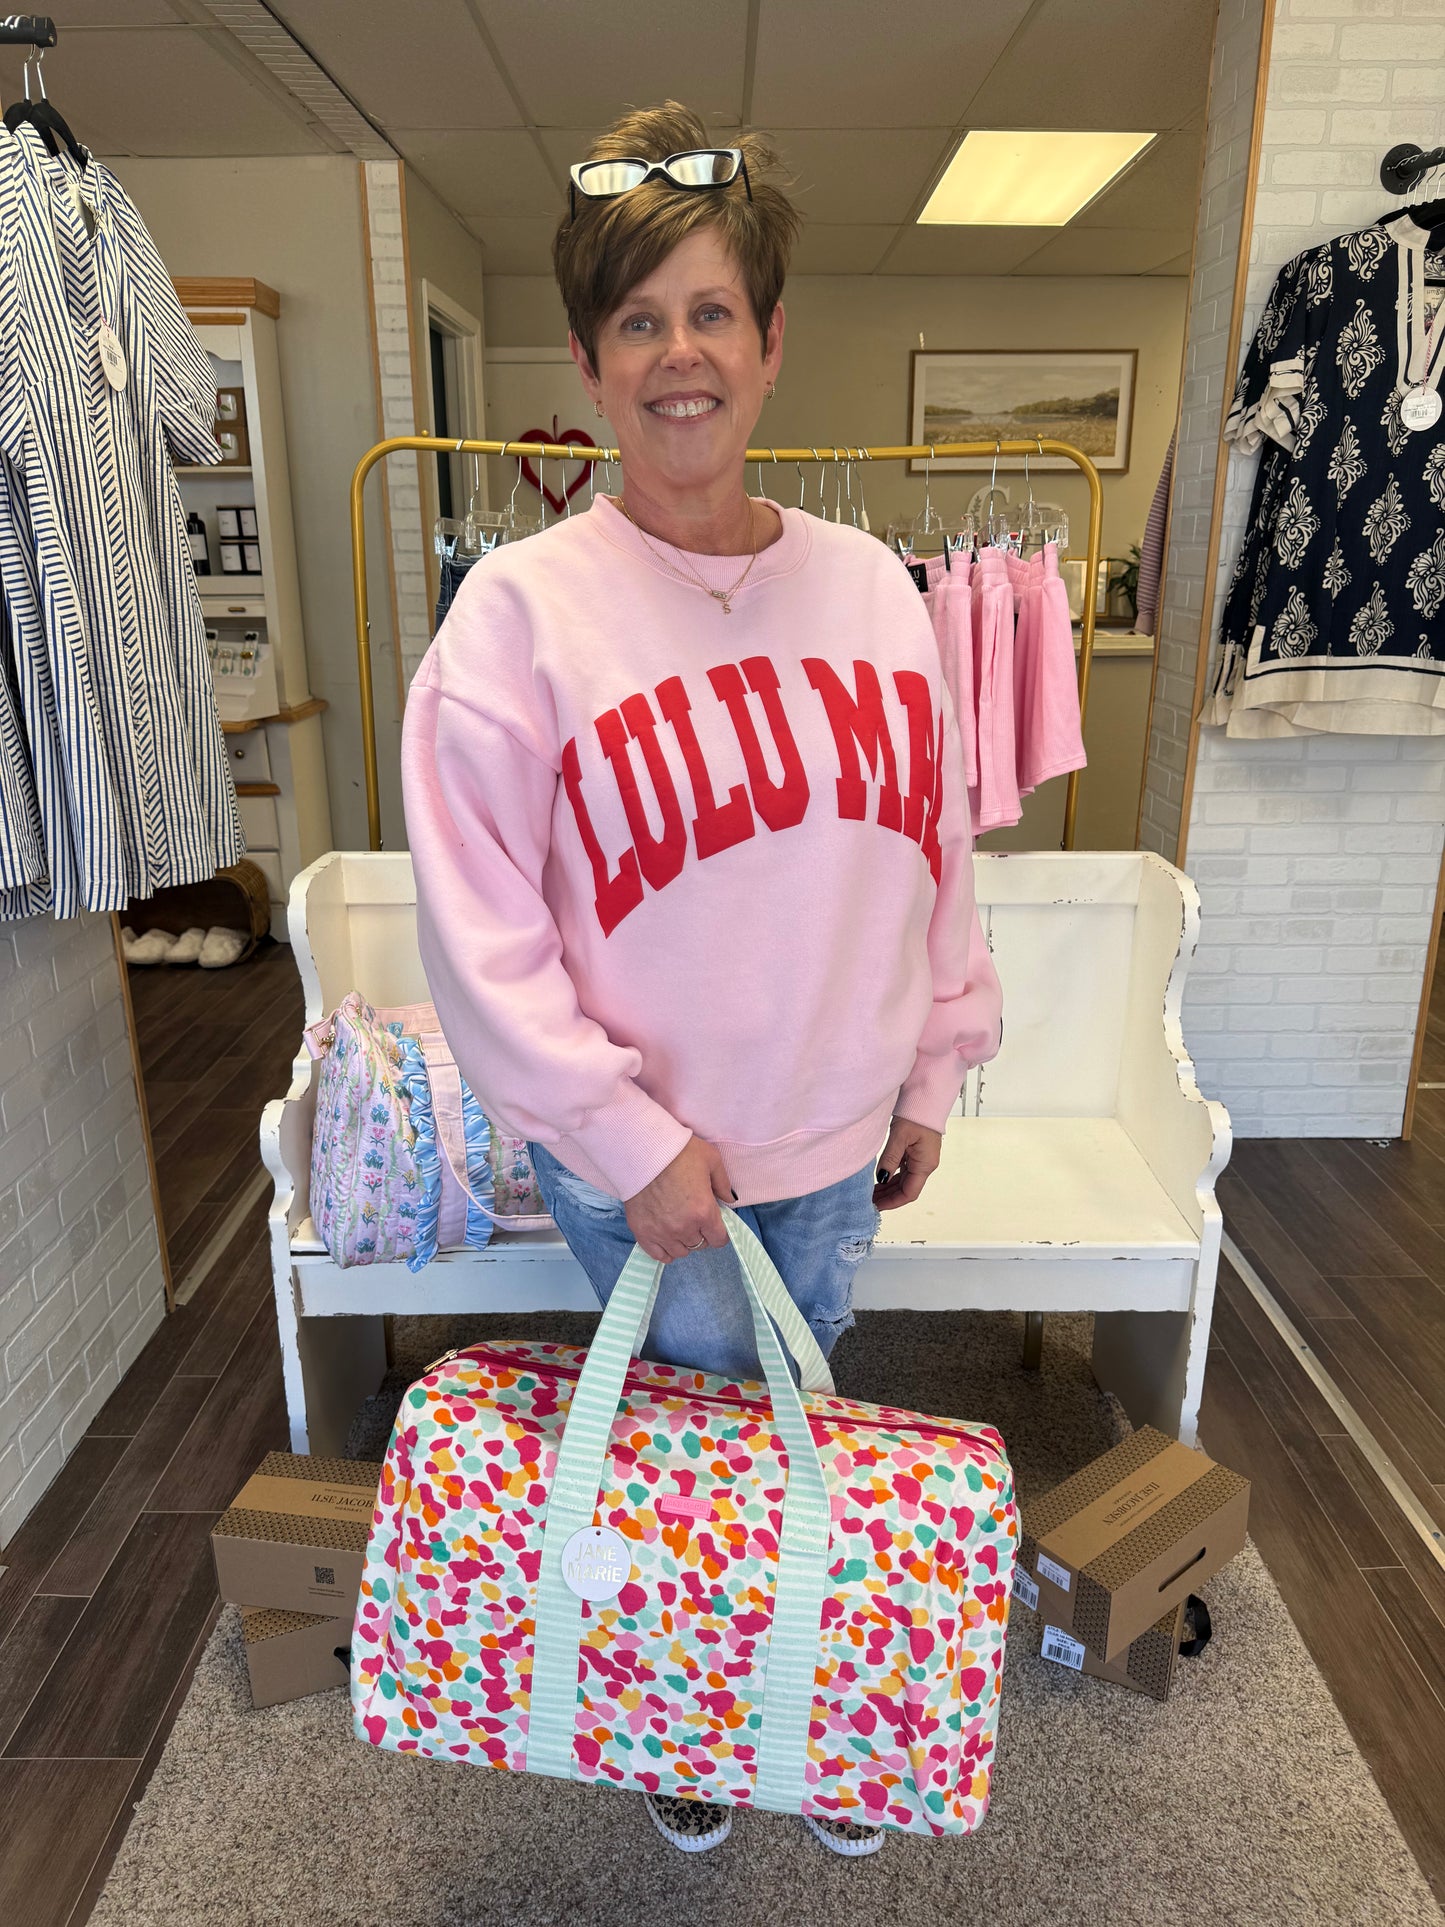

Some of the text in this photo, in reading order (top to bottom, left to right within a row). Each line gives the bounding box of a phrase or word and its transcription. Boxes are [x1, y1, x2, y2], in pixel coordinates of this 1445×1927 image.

[561, 656, 811, 940] LULU
[311, 1493, 337, 1505] ILSE
[1139, 1481, 1161, 1498] ILSE
[1102, 1493, 1144, 1526] JACOBSEN
[574, 1542, 618, 1562] JANE
